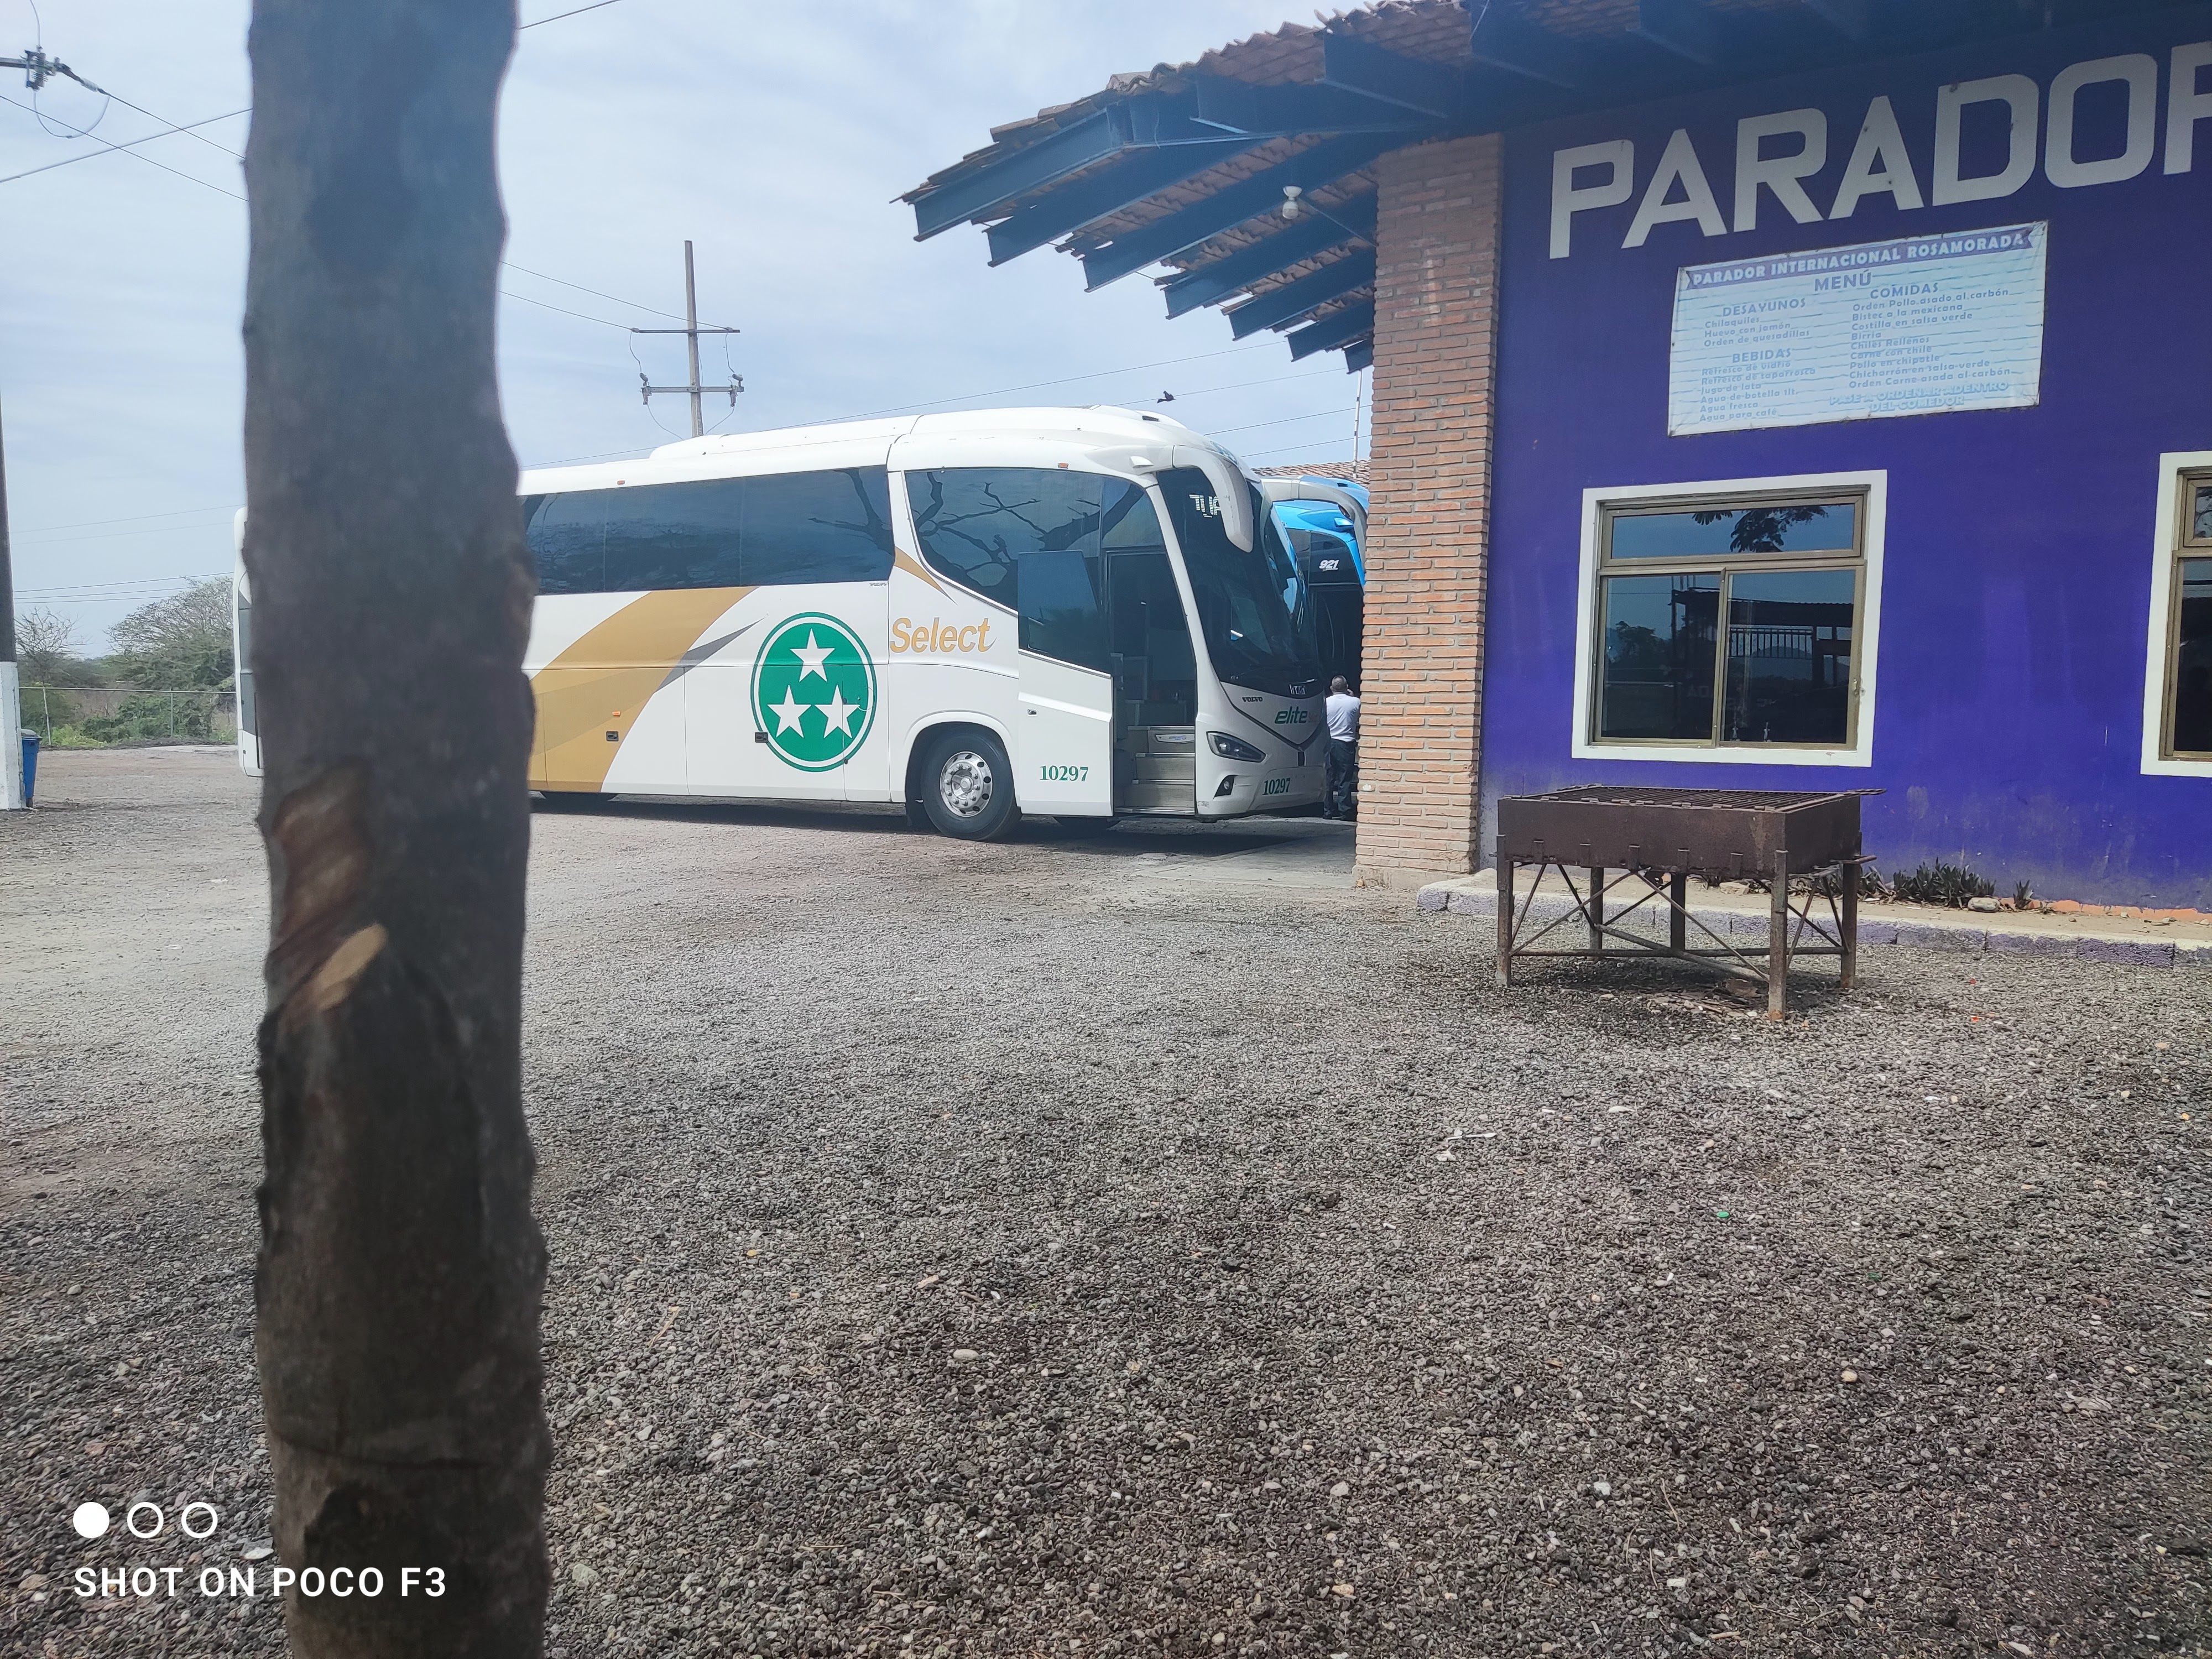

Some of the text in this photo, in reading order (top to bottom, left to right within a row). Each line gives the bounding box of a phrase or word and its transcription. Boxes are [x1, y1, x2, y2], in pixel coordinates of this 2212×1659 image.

[1693, 233, 2023, 286] PARADOR INTERNACIONAL ROSAMORADA
[1814, 269, 1871, 291] MENÚ
[1853, 288, 2008, 311] Orden Pollo asado al carbón
[1870, 283, 1938, 299] COMIDAS
[1723, 298, 1806, 316] DESAYUNOS
[1853, 311, 1883, 321] Bistec
[1911, 304, 1963, 315] mexicana
[1704, 330, 1735, 338] Huevo
[1759, 322, 1791, 333] jamón
[1705, 317, 1759, 328] Chilaquiles
[1852, 320, 1891, 331] Costilla
[1911, 315, 1938, 325] salsa
[1942, 312, 1973, 321] verde
[1704, 338, 1734, 347] Orden
[1753, 330, 1810, 342] quesadillas
[1850, 337, 1929, 350] Chiles Rellenos
[1851, 332, 1882, 340] Birria
[1732, 348, 1791, 363] BEBIDAS
[1850, 351, 1881, 359] Carne
[1907, 345, 1932, 354] chile
[1849, 367, 1908, 379] Chicharrón
[1928, 362, 1955, 372] salsa
[1958, 359, 1990, 369] verde
[1850, 361, 1876, 369] Pollo
[1897, 354, 1940, 365] chipotle
[1702, 367, 1742, 375] Refresco
[1849, 367, 2011, 388] Orden Carne asada al carbón
[1700, 387, 1723, 395] Jugo
[1745, 390, 1780, 399] botella
[1876, 386, 1941, 401] ORDENAR
[1943, 382, 2009, 395] ADENTRO
[1756, 408, 1777, 416] café
[1869, 396, 1965, 413] DEL COMEDOR
[1319, 559, 1339, 570] 921
[889, 617, 997, 653] Select
[1274, 706, 1308, 724] elite
[1040, 765, 1089, 782] 10297
[1261, 777, 1291, 795] 10297
